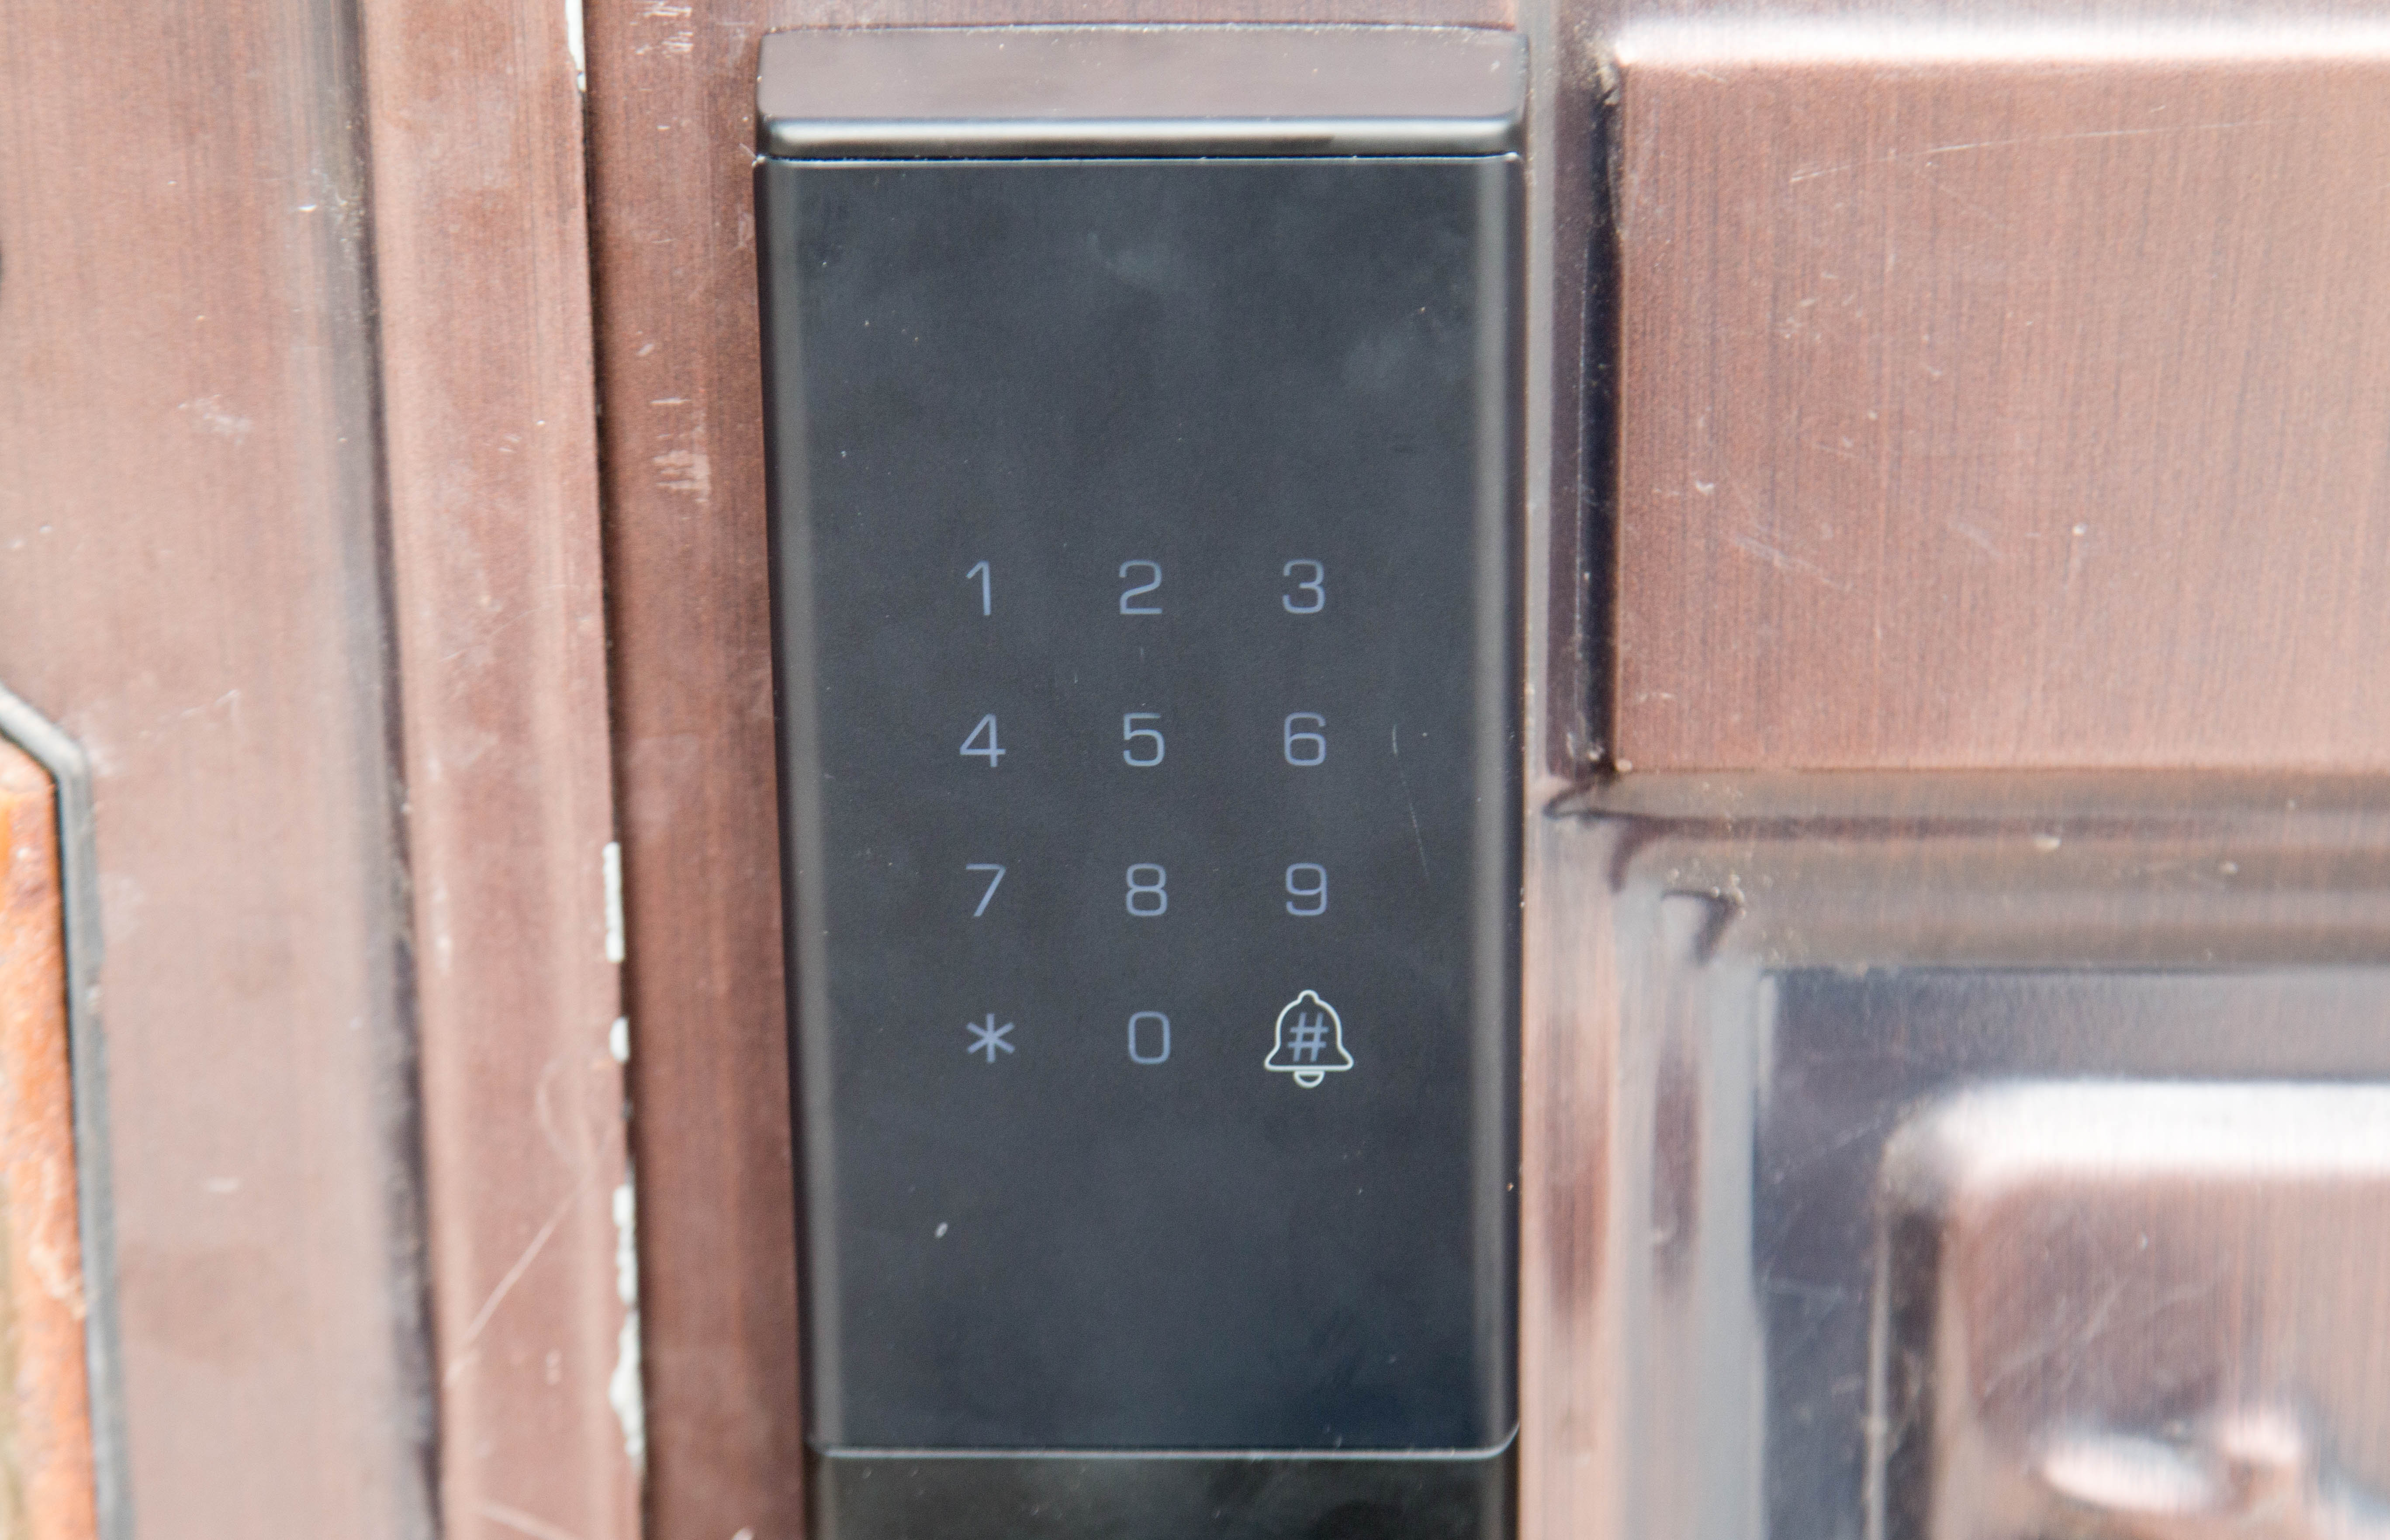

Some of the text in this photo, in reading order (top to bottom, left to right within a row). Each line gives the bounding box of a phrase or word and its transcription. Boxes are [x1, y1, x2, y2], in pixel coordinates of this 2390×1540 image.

[965, 559, 1326, 617] 1 2 3
[958, 711, 1327, 768] 4 5 6
[965, 862, 1328, 918] 7 8 9
[1288, 1012, 1329, 1062] #
